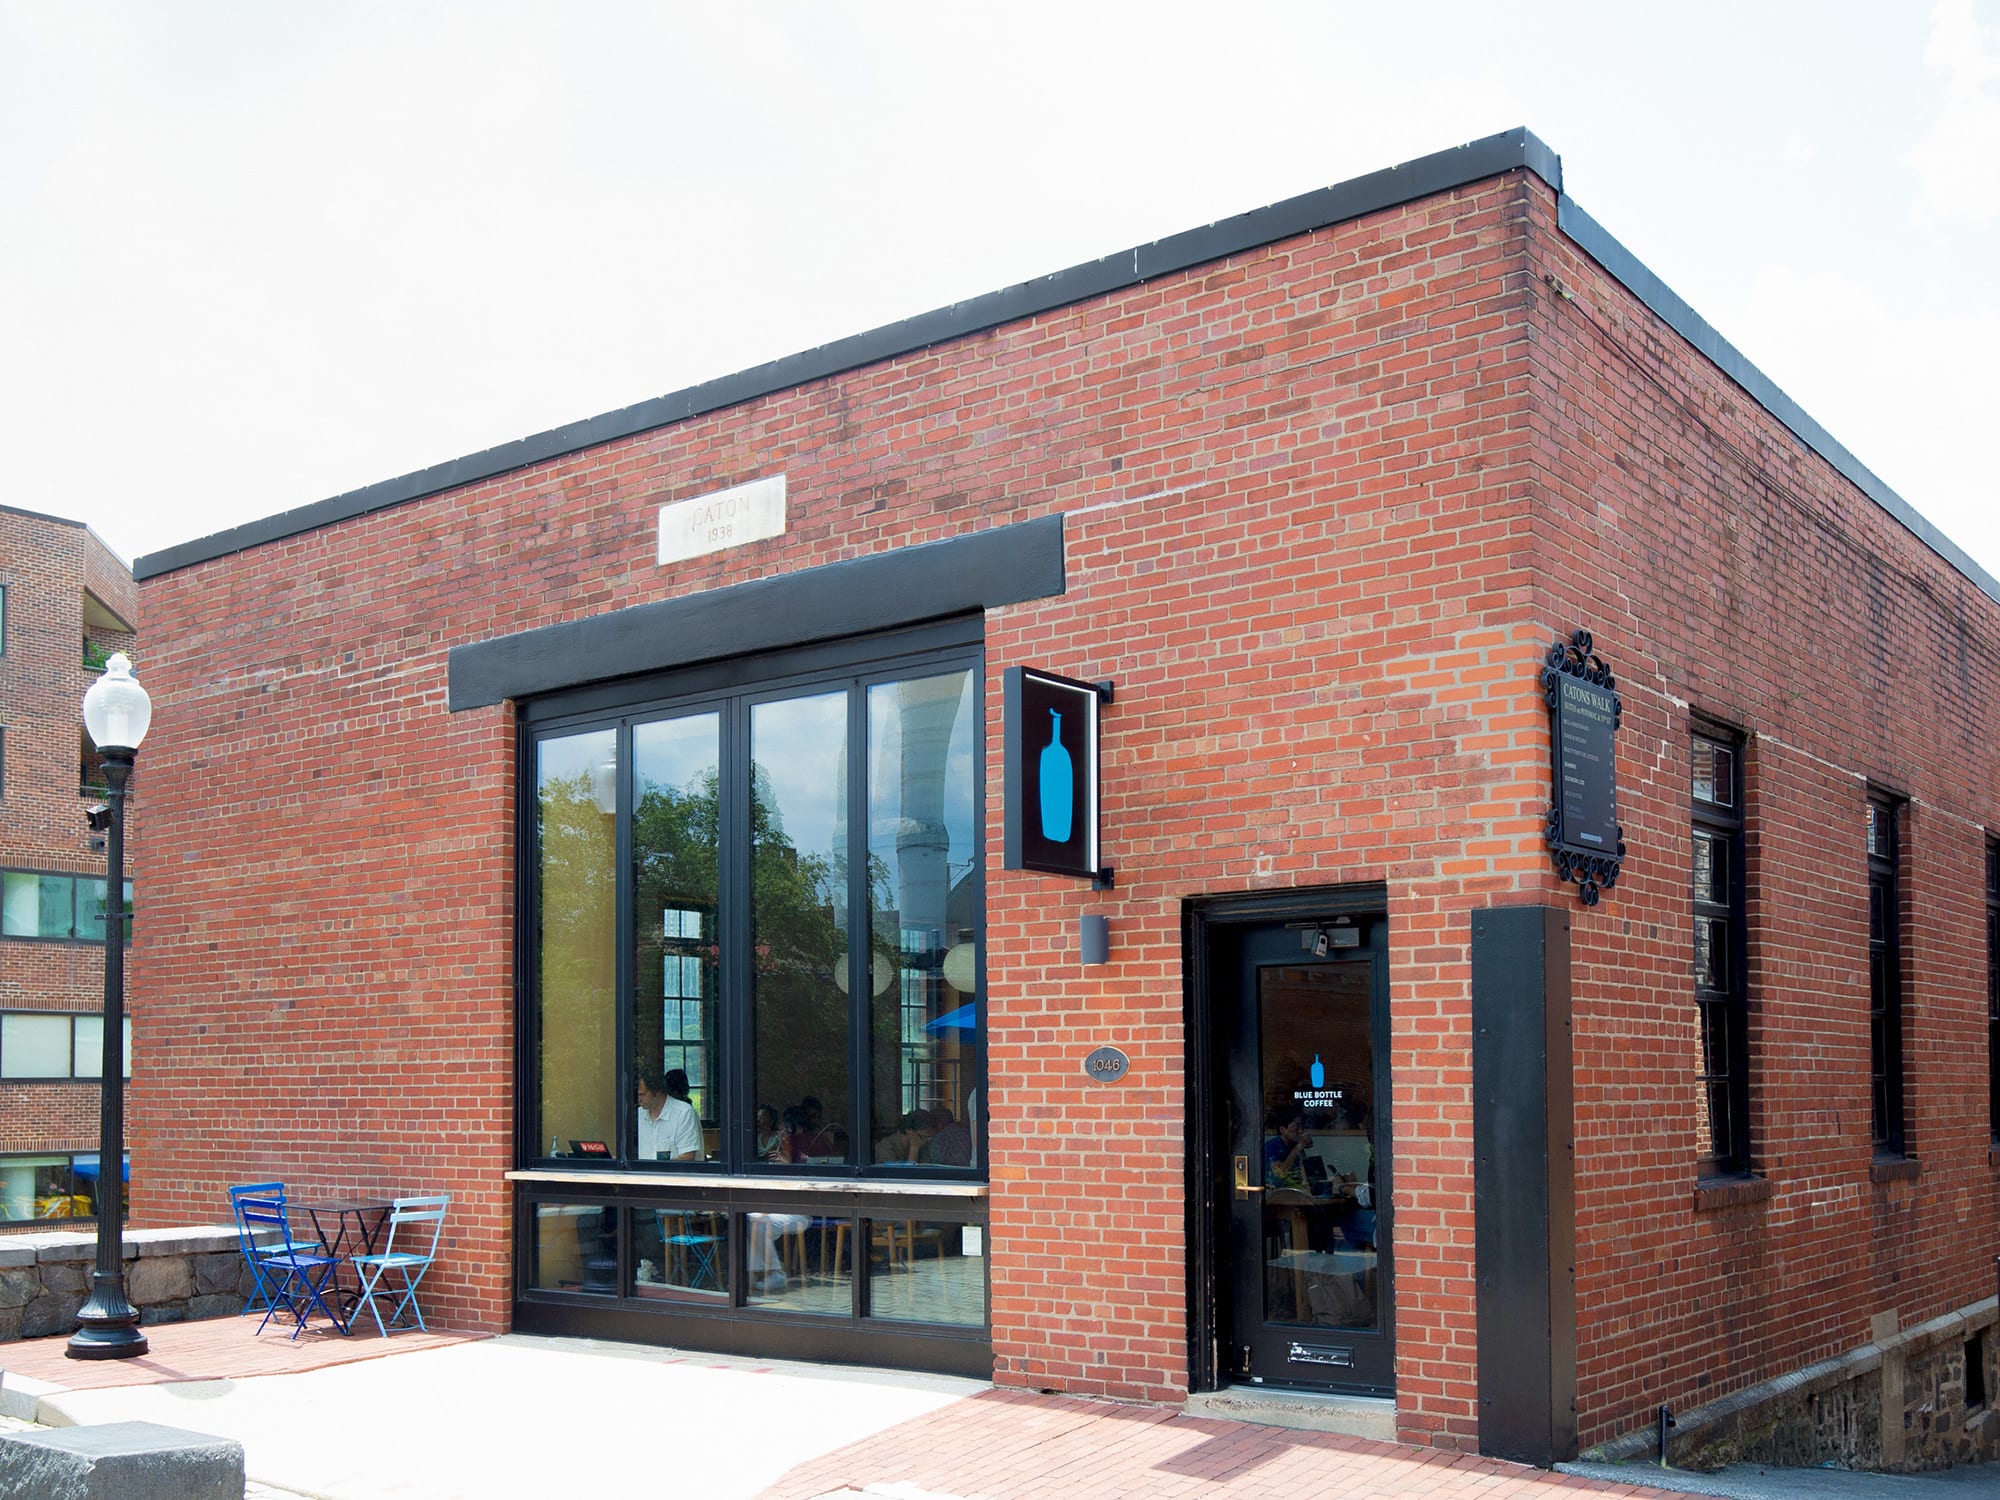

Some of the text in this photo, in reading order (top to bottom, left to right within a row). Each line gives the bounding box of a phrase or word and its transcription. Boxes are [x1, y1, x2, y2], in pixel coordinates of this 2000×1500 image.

[692, 496, 750, 527] CATON
[708, 524, 734, 544] 1938
[1563, 682, 1611, 713] CATONS WALK
[1093, 1058, 1120, 1072] 1046
[1294, 1091, 1343, 1099] BLUE BOTTLE
